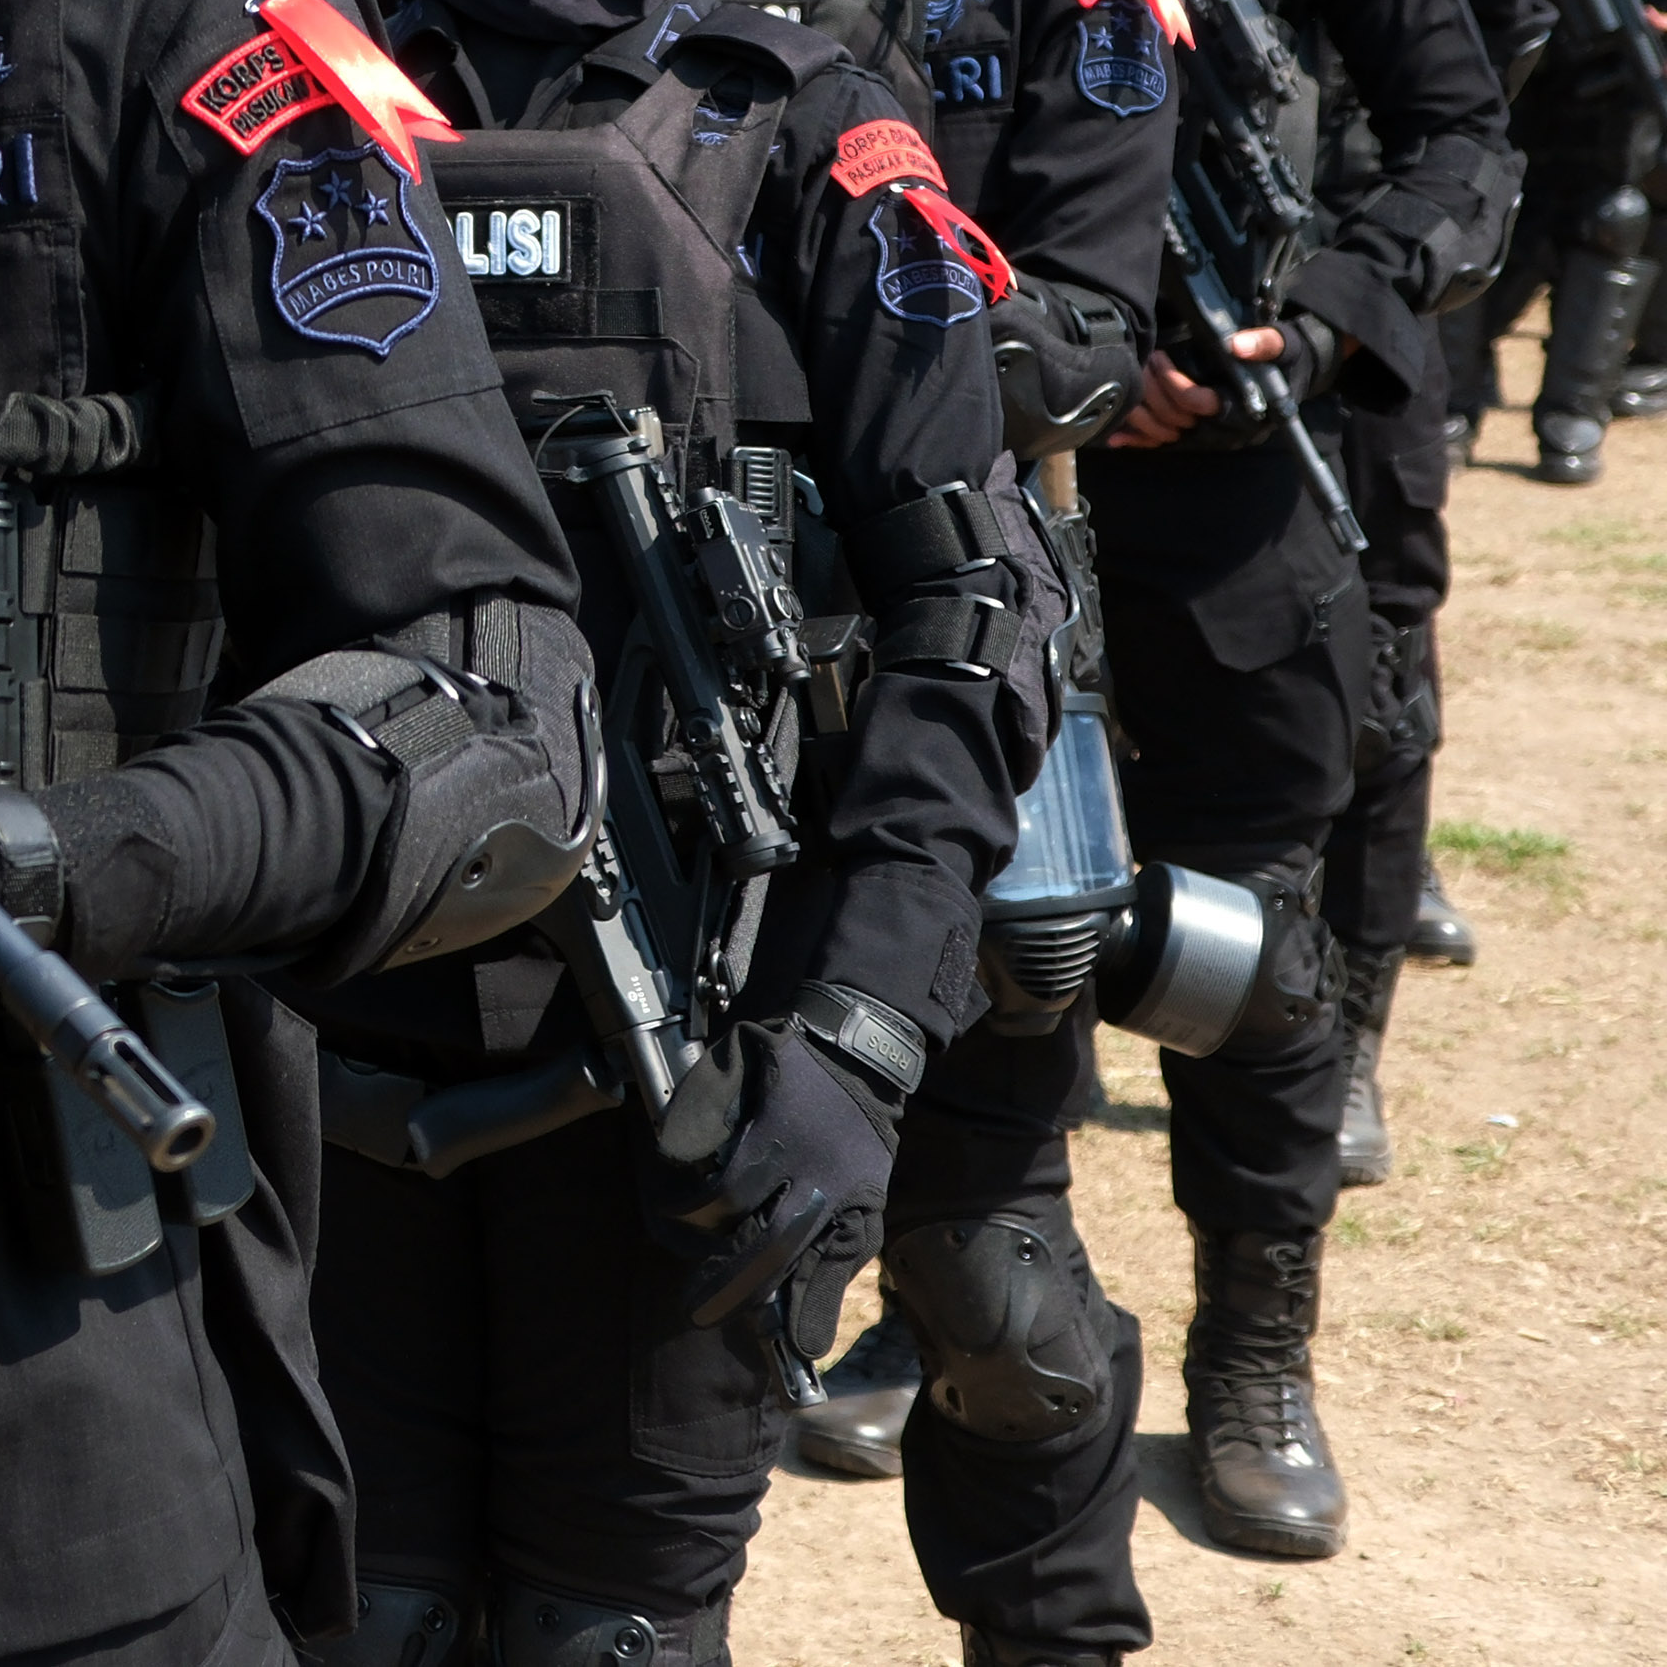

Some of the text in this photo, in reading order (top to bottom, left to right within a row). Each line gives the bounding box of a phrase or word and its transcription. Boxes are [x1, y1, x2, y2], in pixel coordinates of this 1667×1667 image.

[199, 45, 284, 114] KORPS
[231, 73, 310, 138] PASUKAN
[447, 208, 561, 275] LISI
[288, 258, 429, 316] MABES POLRI
[885, 268, 938, 295] MABES
[867, 1033, 912, 1072] RRDS
